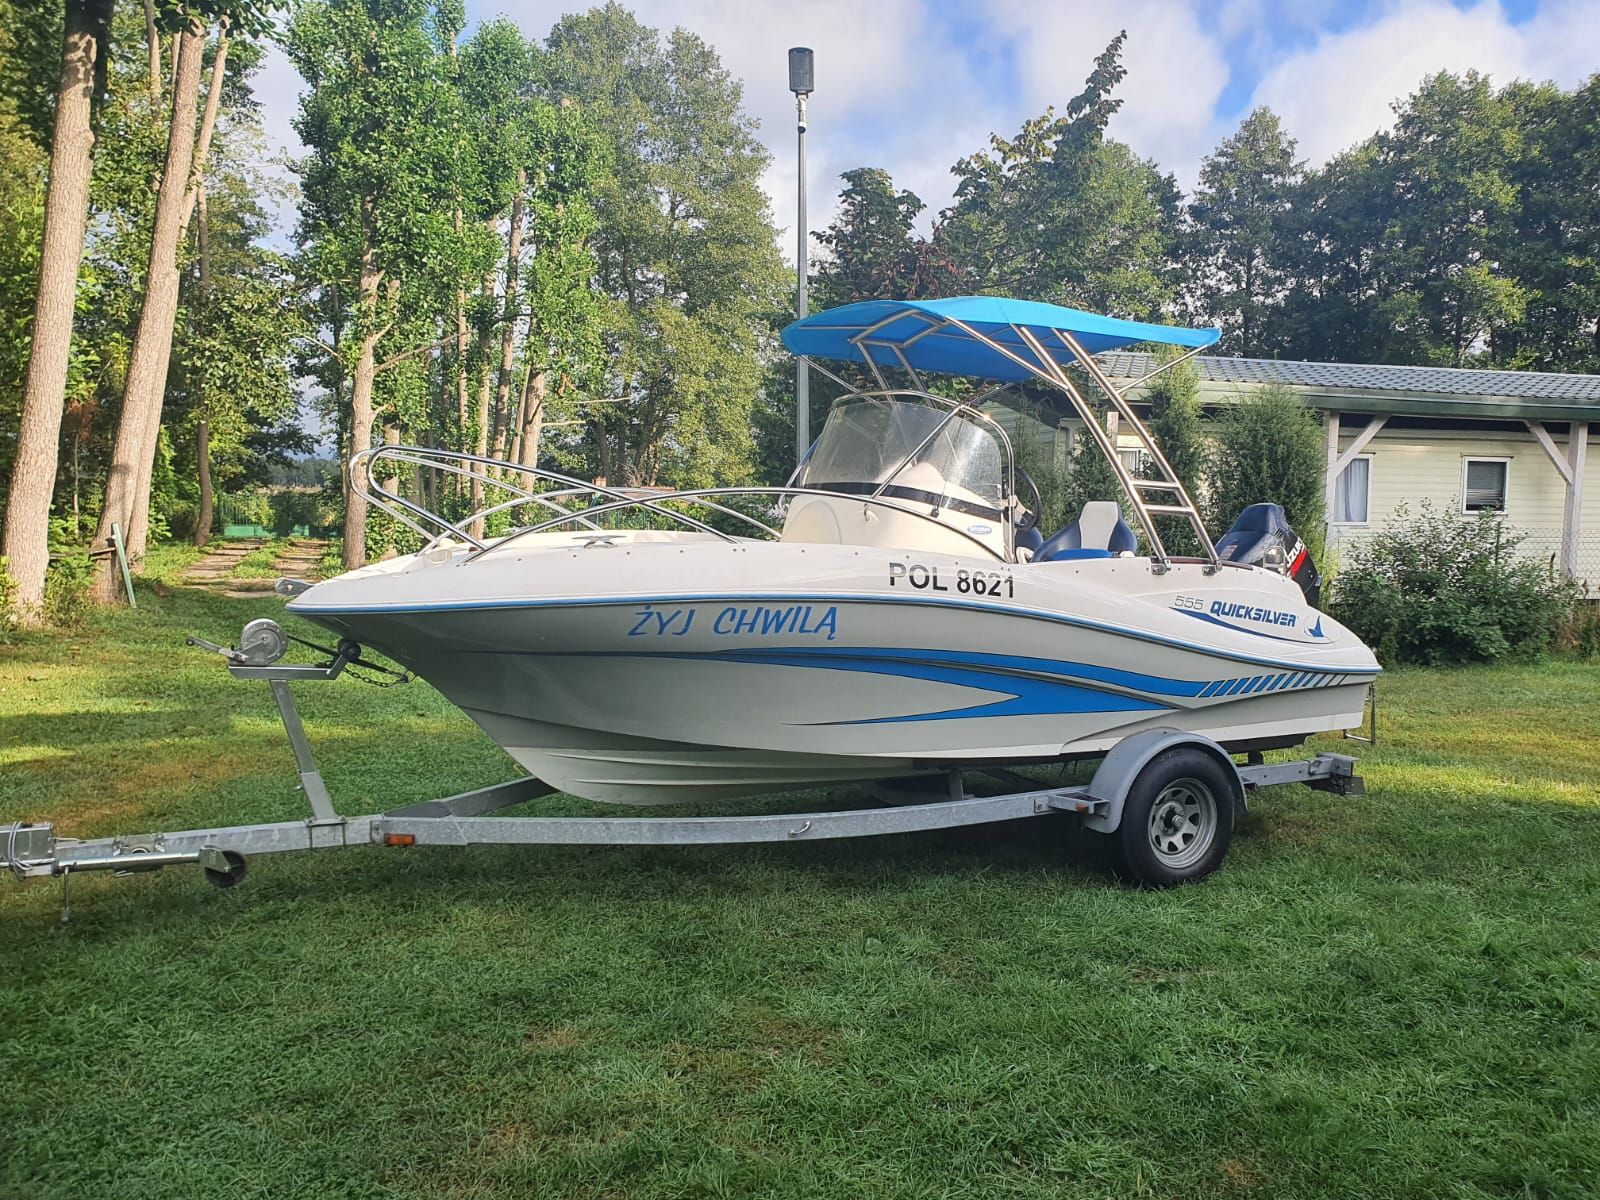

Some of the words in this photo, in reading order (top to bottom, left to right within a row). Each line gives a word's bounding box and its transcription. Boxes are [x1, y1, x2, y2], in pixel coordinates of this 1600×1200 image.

[889, 562, 948, 591] POL
[956, 570, 1015, 598] 8621
[628, 605, 695, 636] ŻYJ
[713, 606, 838, 640] CHWILĄ
[1174, 595, 1204, 610] 555
[1210, 600, 1297, 627] QUICKSILVER
